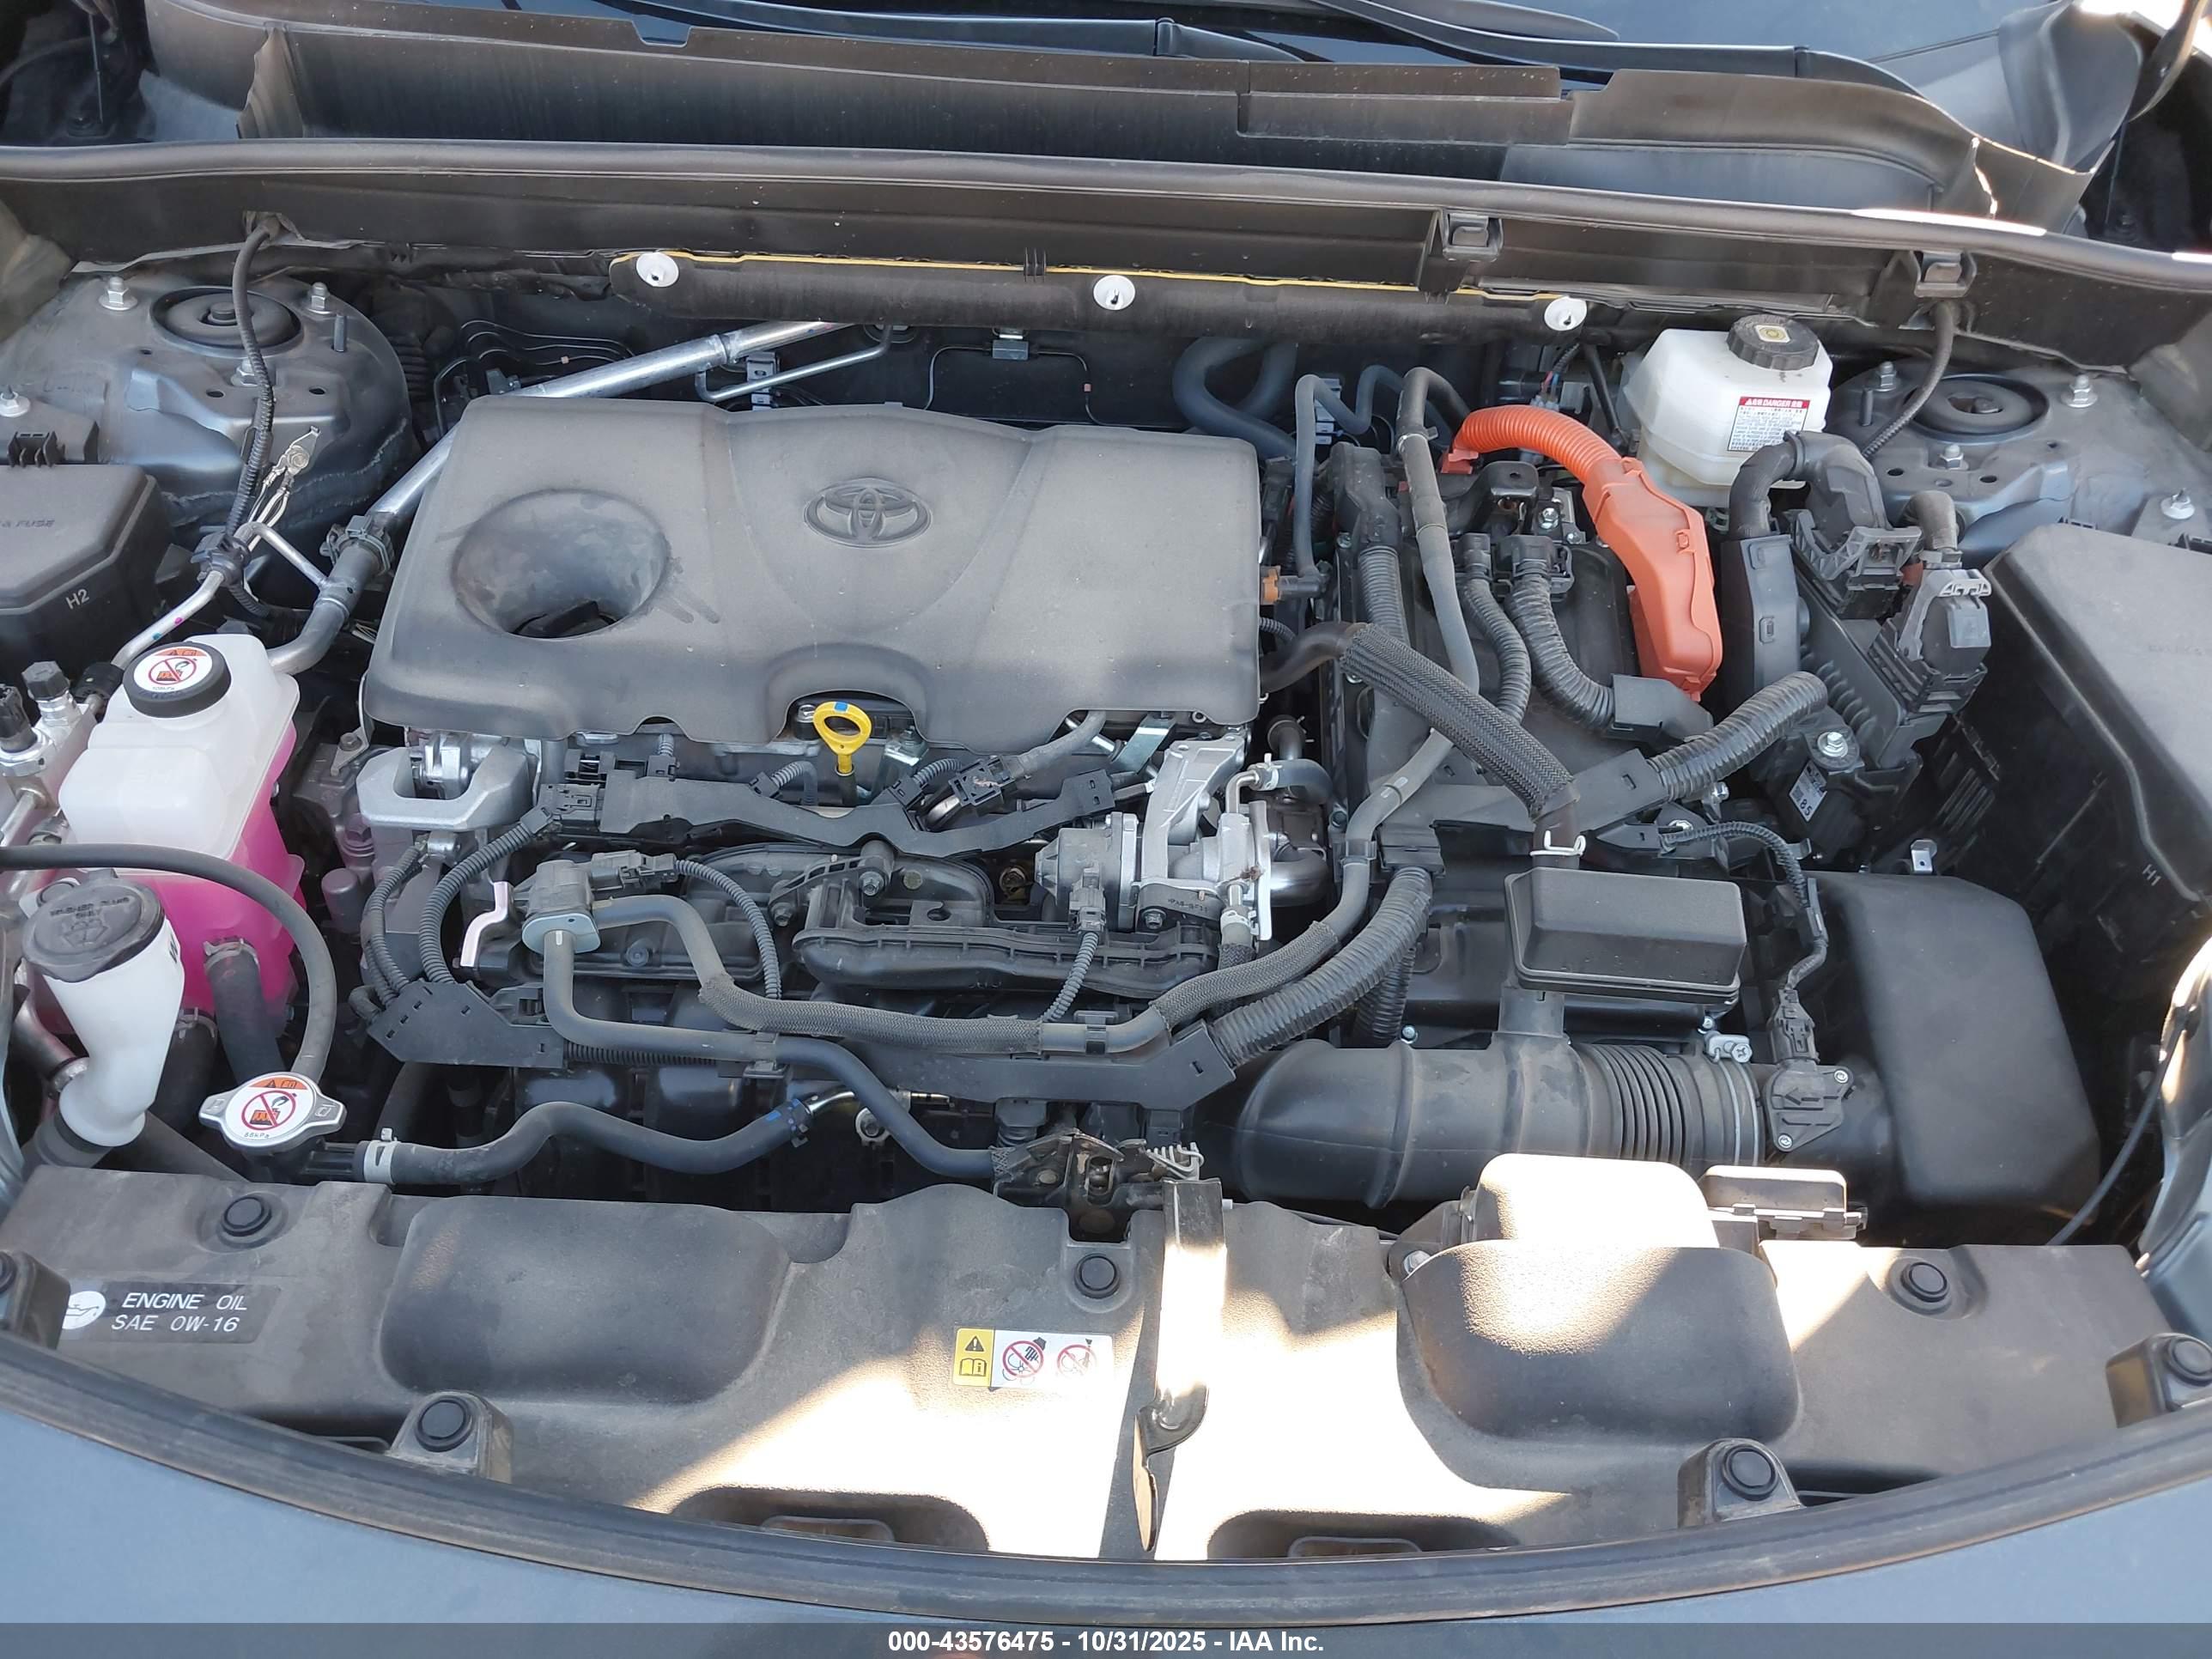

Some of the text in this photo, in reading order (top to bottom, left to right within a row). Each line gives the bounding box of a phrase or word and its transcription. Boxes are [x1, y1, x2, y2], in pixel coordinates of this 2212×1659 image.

[65, 588, 90, 610] H2
[1800, 799, 1813, 816] 85
[2142, 863, 2161, 886] H1
[122, 1292, 247, 1310] ENGINE OIL
[111, 1315, 240, 1332] SAE 0W-16
